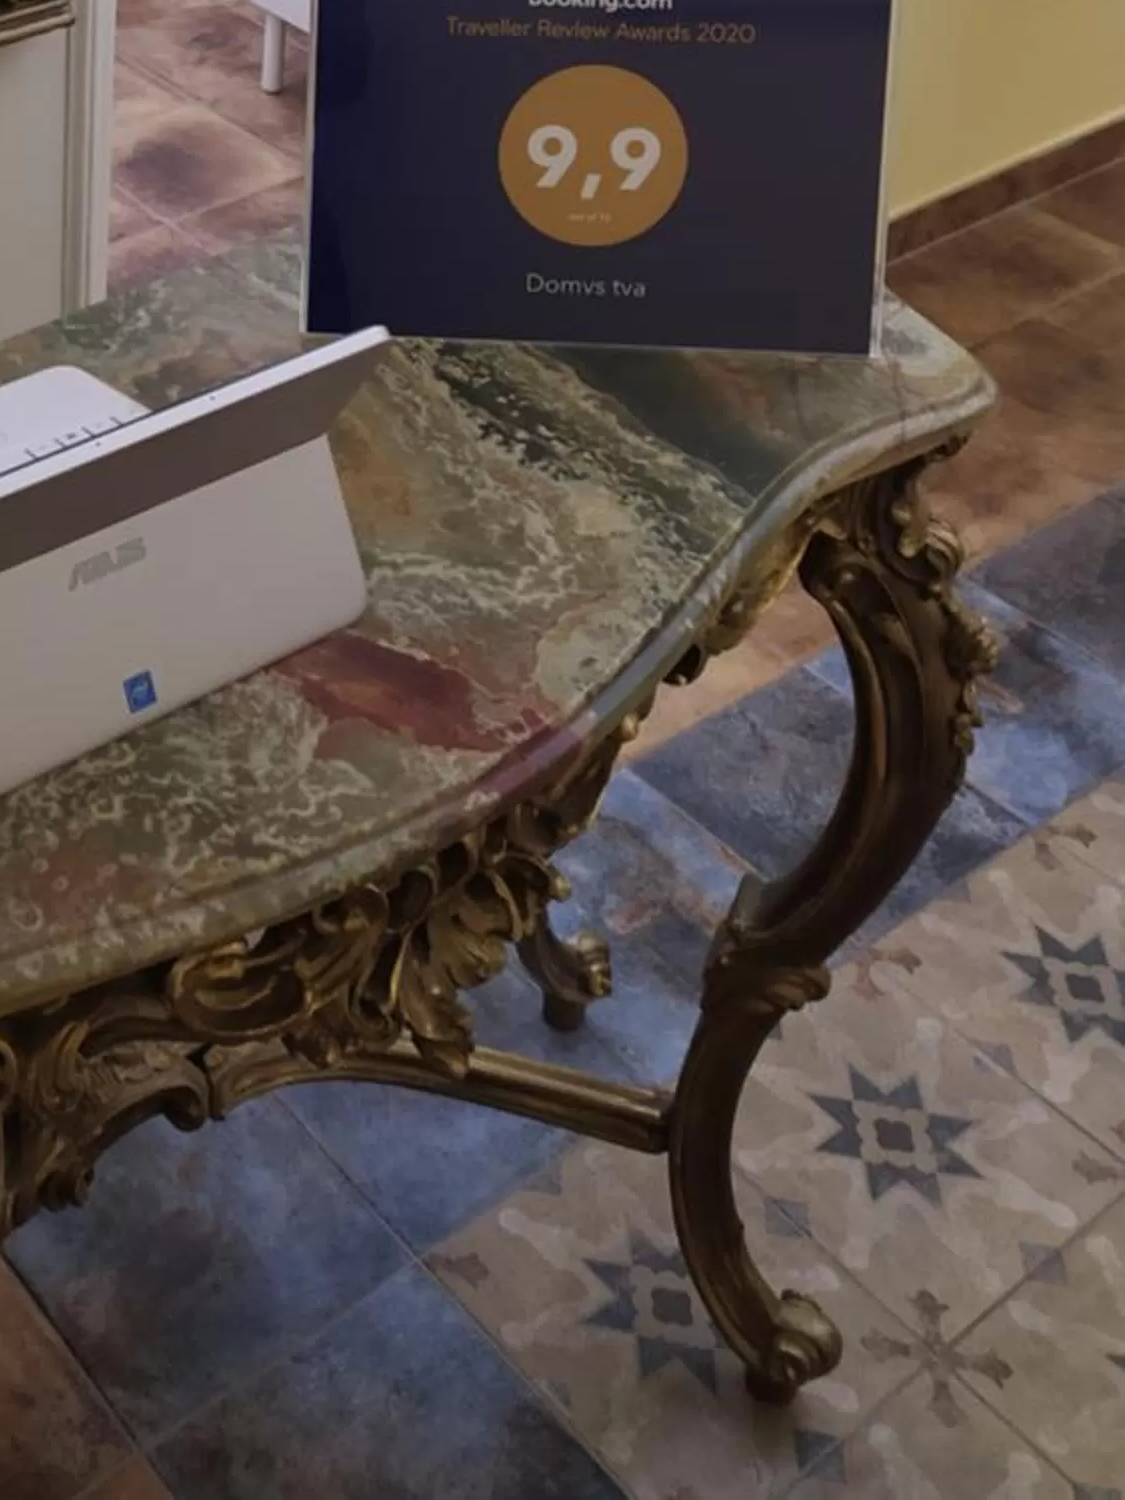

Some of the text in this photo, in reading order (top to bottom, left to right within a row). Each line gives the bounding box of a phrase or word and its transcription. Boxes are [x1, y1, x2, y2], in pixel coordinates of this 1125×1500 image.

[446, 16, 756, 44] Traveller Review Awards 2020
[528, 124, 661, 200] 9,9
[526, 272, 646, 298] Domvs tva
[68, 535, 147, 592] ASUS
